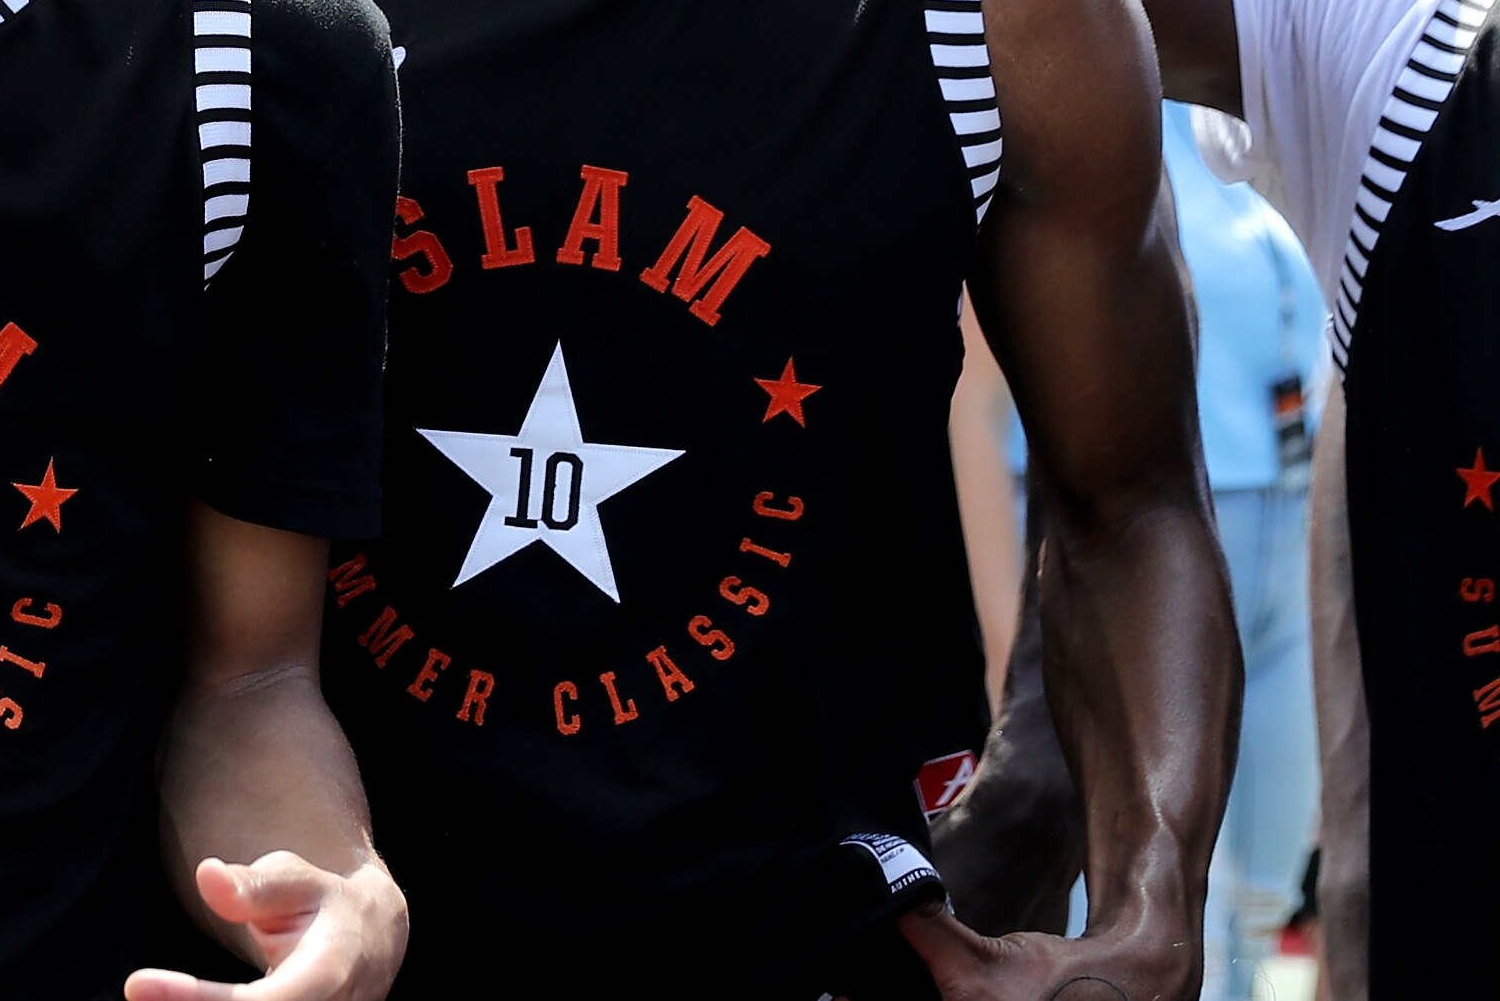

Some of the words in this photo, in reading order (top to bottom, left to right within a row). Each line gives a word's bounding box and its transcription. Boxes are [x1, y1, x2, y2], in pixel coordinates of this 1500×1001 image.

[392, 164, 772, 327] SLAM
[503, 447, 584, 532] 10
[327, 552, 495, 727] MMER
[553, 490, 805, 736] CLASSIC
[1460, 577, 1500, 729] SUM
[890, 868, 941, 894] AUTHEN
